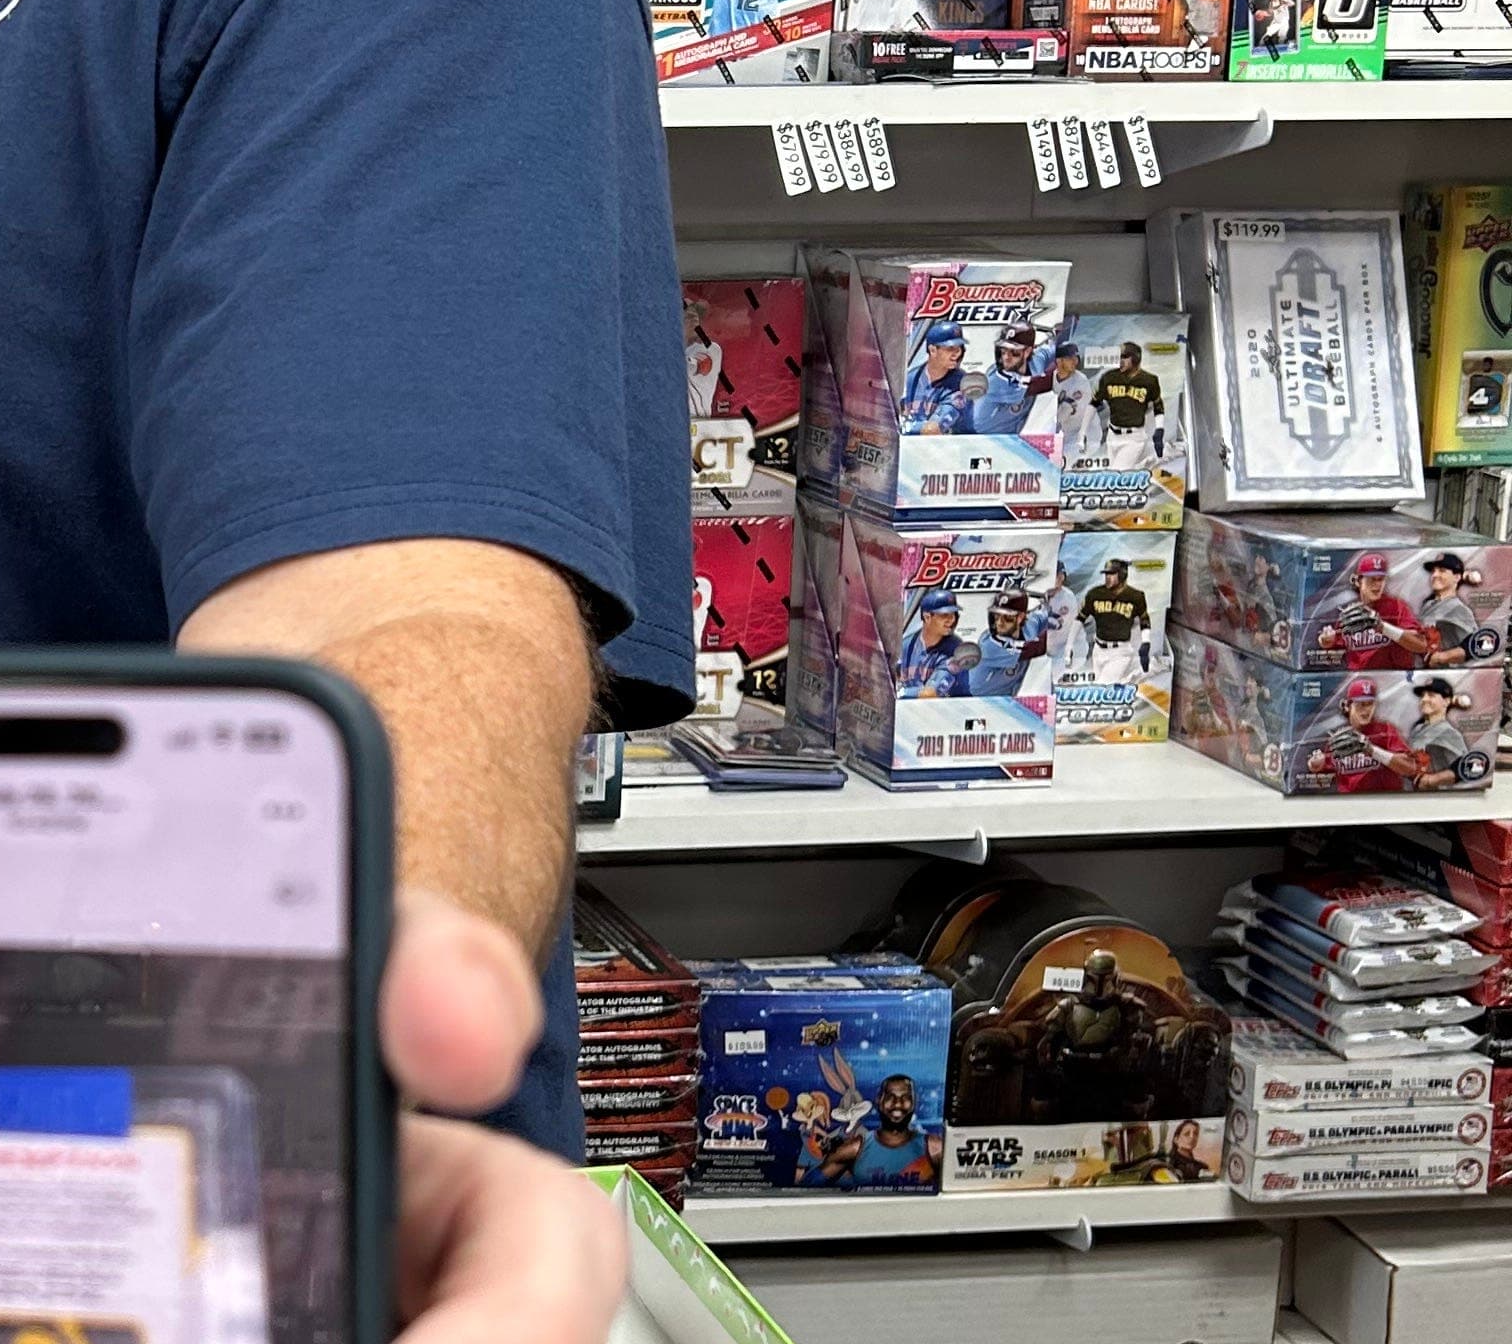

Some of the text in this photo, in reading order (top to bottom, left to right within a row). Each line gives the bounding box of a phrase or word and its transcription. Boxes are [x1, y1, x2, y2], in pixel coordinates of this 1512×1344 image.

[872, 43, 907, 57] 10 FREE
[775, 121, 806, 188] $679.99
[804, 119, 839, 185] $679.99
[833, 118, 864, 183] $384.99
[862, 117, 891, 182] $589.99
[1030, 118, 1056, 183] $149.99
[1062, 115, 1085, 181] $874.99
[1091, 119, 1117, 180] $64.99
[1127, 115, 1157, 180] $149.99
[1223, 222, 1280, 238] $119.99
[914, 277, 1045, 319] Bowman's
[951, 302, 1021, 323] BEST
[1247, 328, 1262, 379] 2020
[1281, 299, 1302, 408] ULTIMATE
[1297, 302, 1329, 406] DRAFT
[1326, 299, 1346, 407] BASEBALL
[921, 472, 1041, 495] 2019 TRADING CARDS
[908, 547, 1037, 587] Bowman's
[944, 571, 1012, 592] BEST
[916, 732, 1036, 756] 2019 TRADING CARDS
[607, 996, 663, 1004] AUTOGRAPHS
[714, 1095, 756, 1113] SPACE
[963, 1137, 1023, 1154] STAR
[1033, 1149, 1077, 1160] SEASON
[1267, 1126, 1304, 1147] Topps
[1329, 1126, 1377, 1138] OLYMPIC
[1383, 1123, 1454, 1136] PARALYMPIC
[955, 1151, 1024, 1167] WARS
